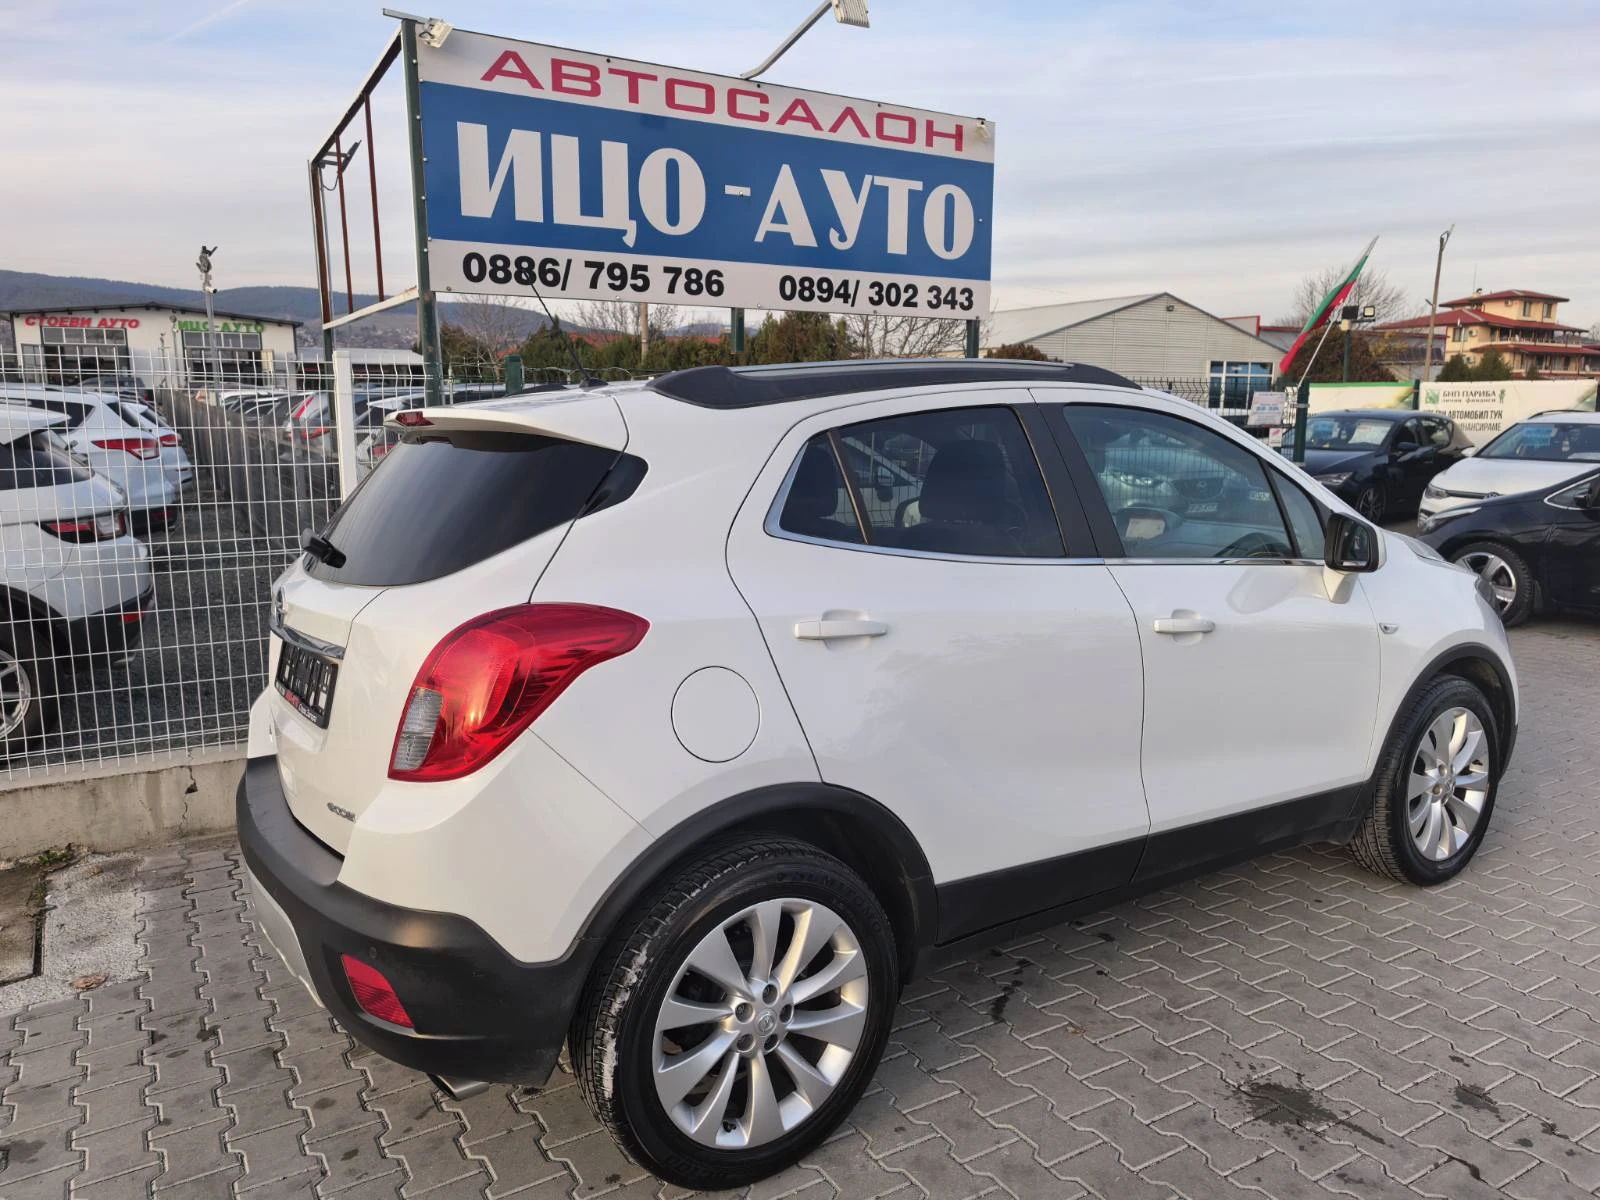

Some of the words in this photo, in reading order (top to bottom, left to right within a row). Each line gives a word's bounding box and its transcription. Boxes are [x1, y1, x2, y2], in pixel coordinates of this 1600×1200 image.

[480, 49, 964, 152] АВТОСАЛОН
[462, 251, 572, 292] 0886/
[584, 260, 650, 292] 795
[662, 265, 725, 297] 786
[779, 274, 860, 307] 0894/
[868, 280, 918, 307] 302
[926, 285, 974, 311] 343
[25, 316, 92, 328] СТОЕВИ
[98, 318, 140, 329] АУТО
[1462, 390, 1496, 398] ПАРИБА
[1490, 410, 1503, 420] ТУК
